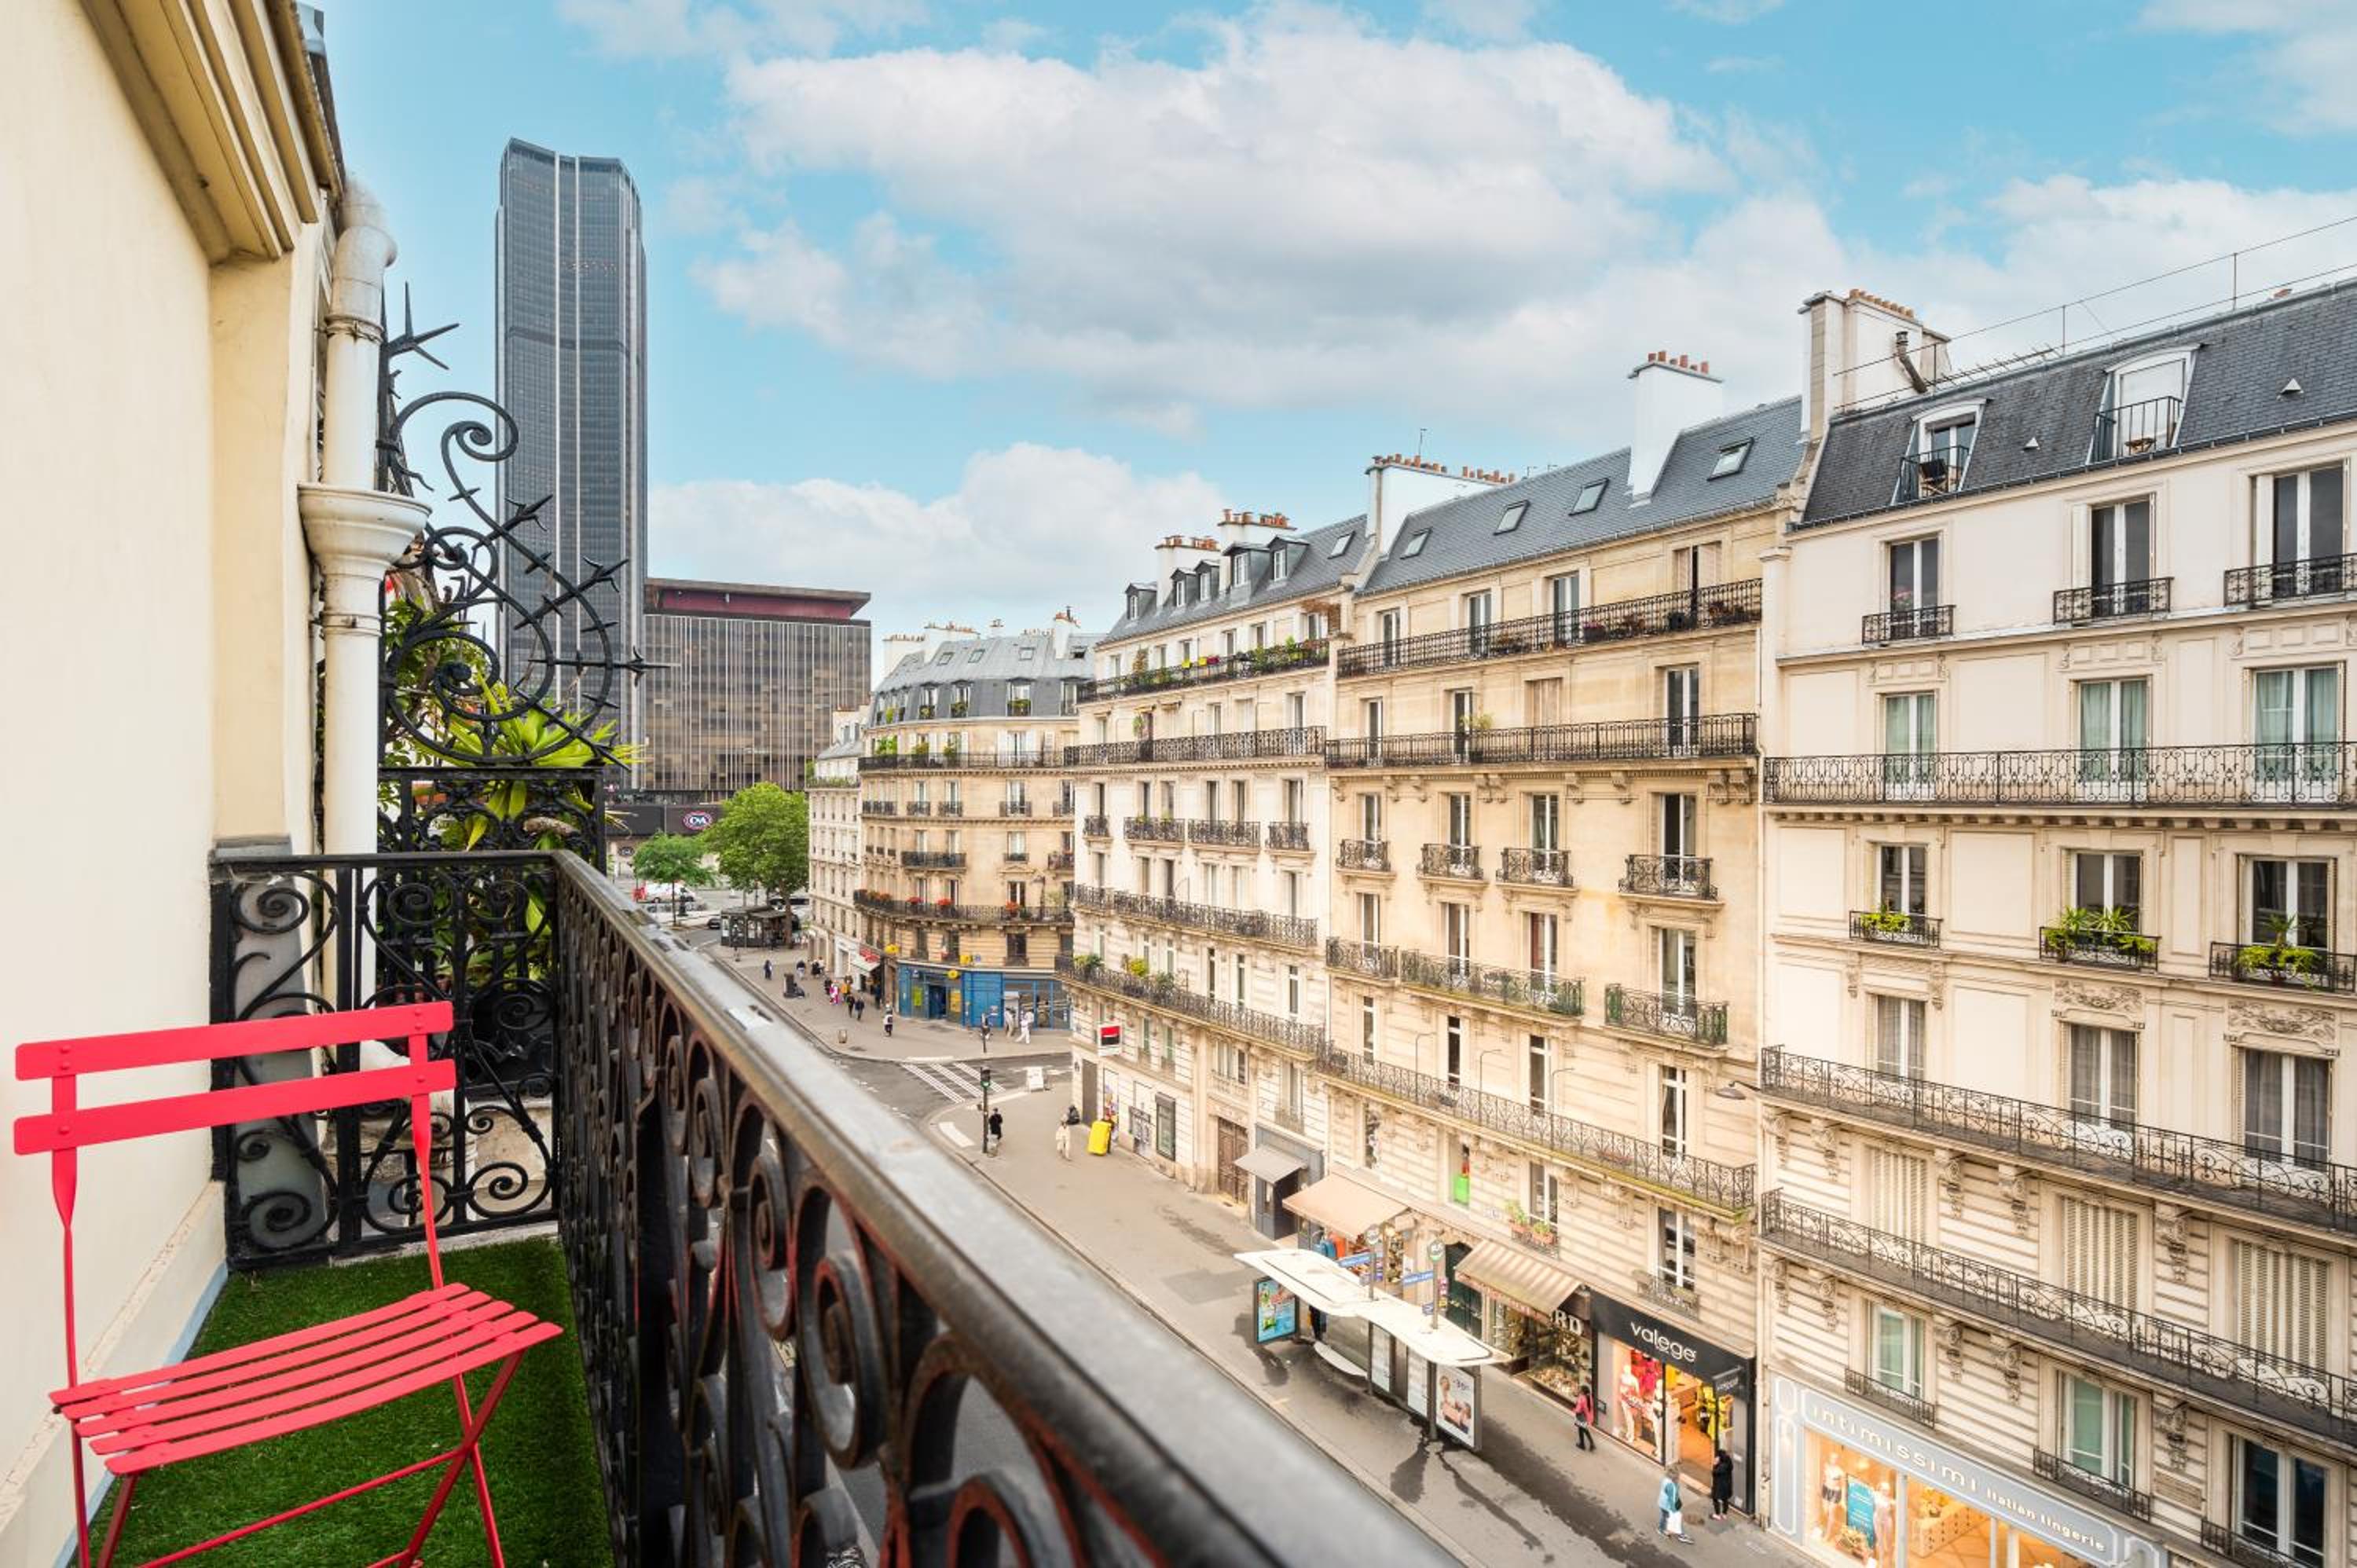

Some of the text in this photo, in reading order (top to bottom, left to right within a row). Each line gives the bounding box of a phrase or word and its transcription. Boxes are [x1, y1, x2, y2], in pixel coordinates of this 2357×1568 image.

[1553, 1310, 1584, 1336] RD
[1630, 1321, 1697, 1362] valege
[1813, 1406, 1977, 1491] intimissimi
